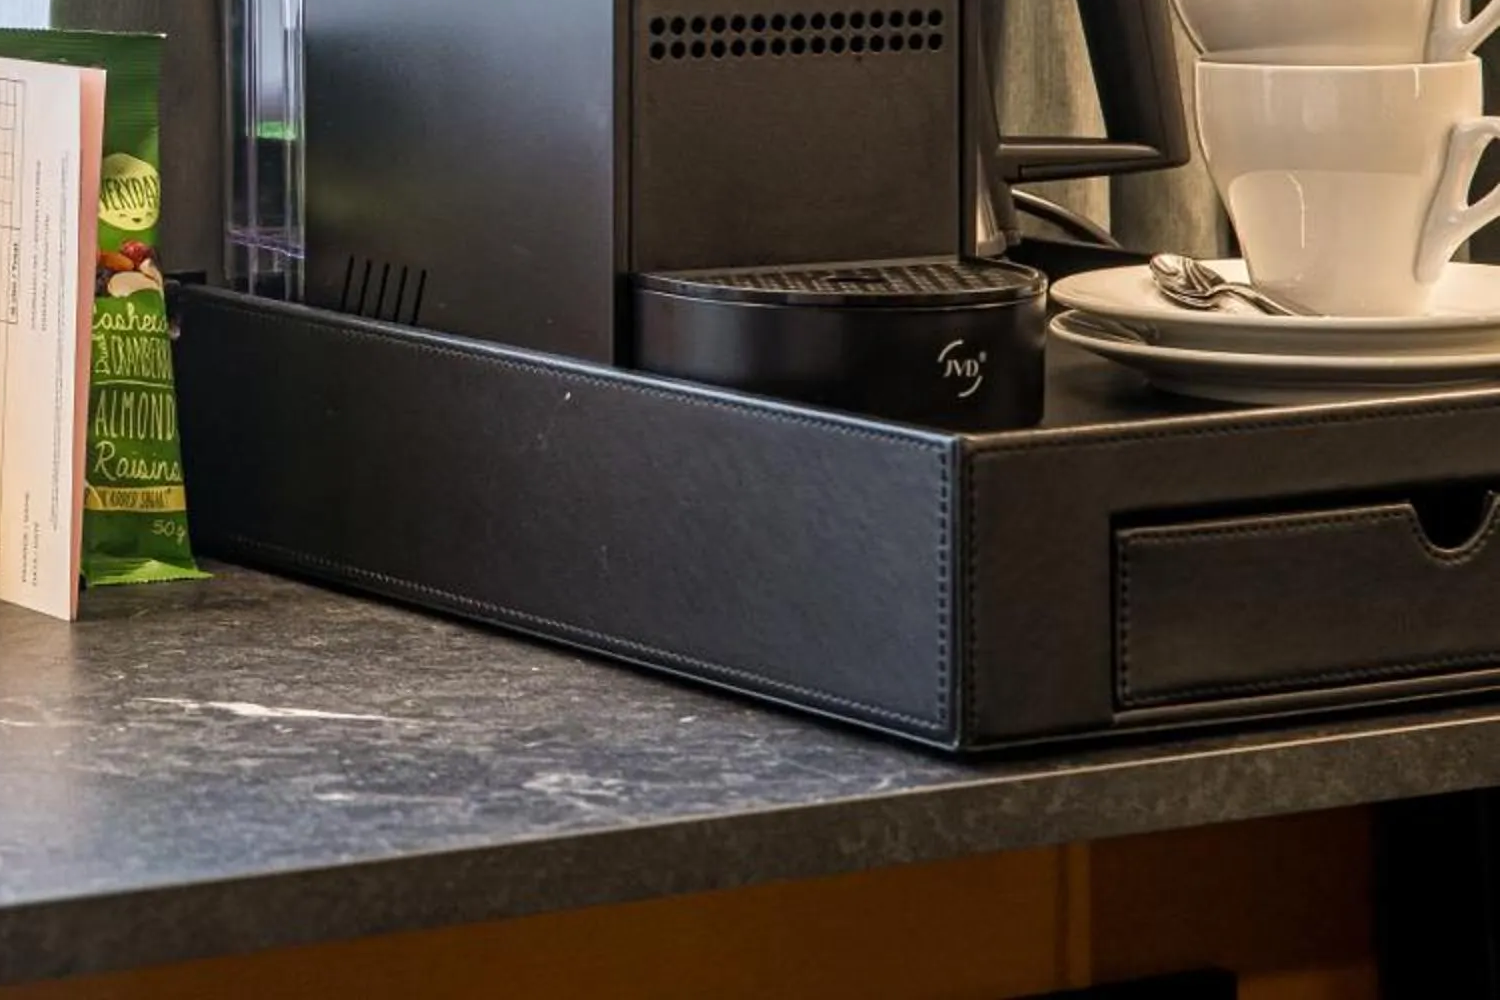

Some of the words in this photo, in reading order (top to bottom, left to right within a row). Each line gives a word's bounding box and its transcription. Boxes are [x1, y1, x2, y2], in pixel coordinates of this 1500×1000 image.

[100, 175, 159, 211] VERYDA
[942, 359, 980, 377] JVD
[95, 390, 177, 441] ALMOND
[93, 441, 181, 480] Raisins
